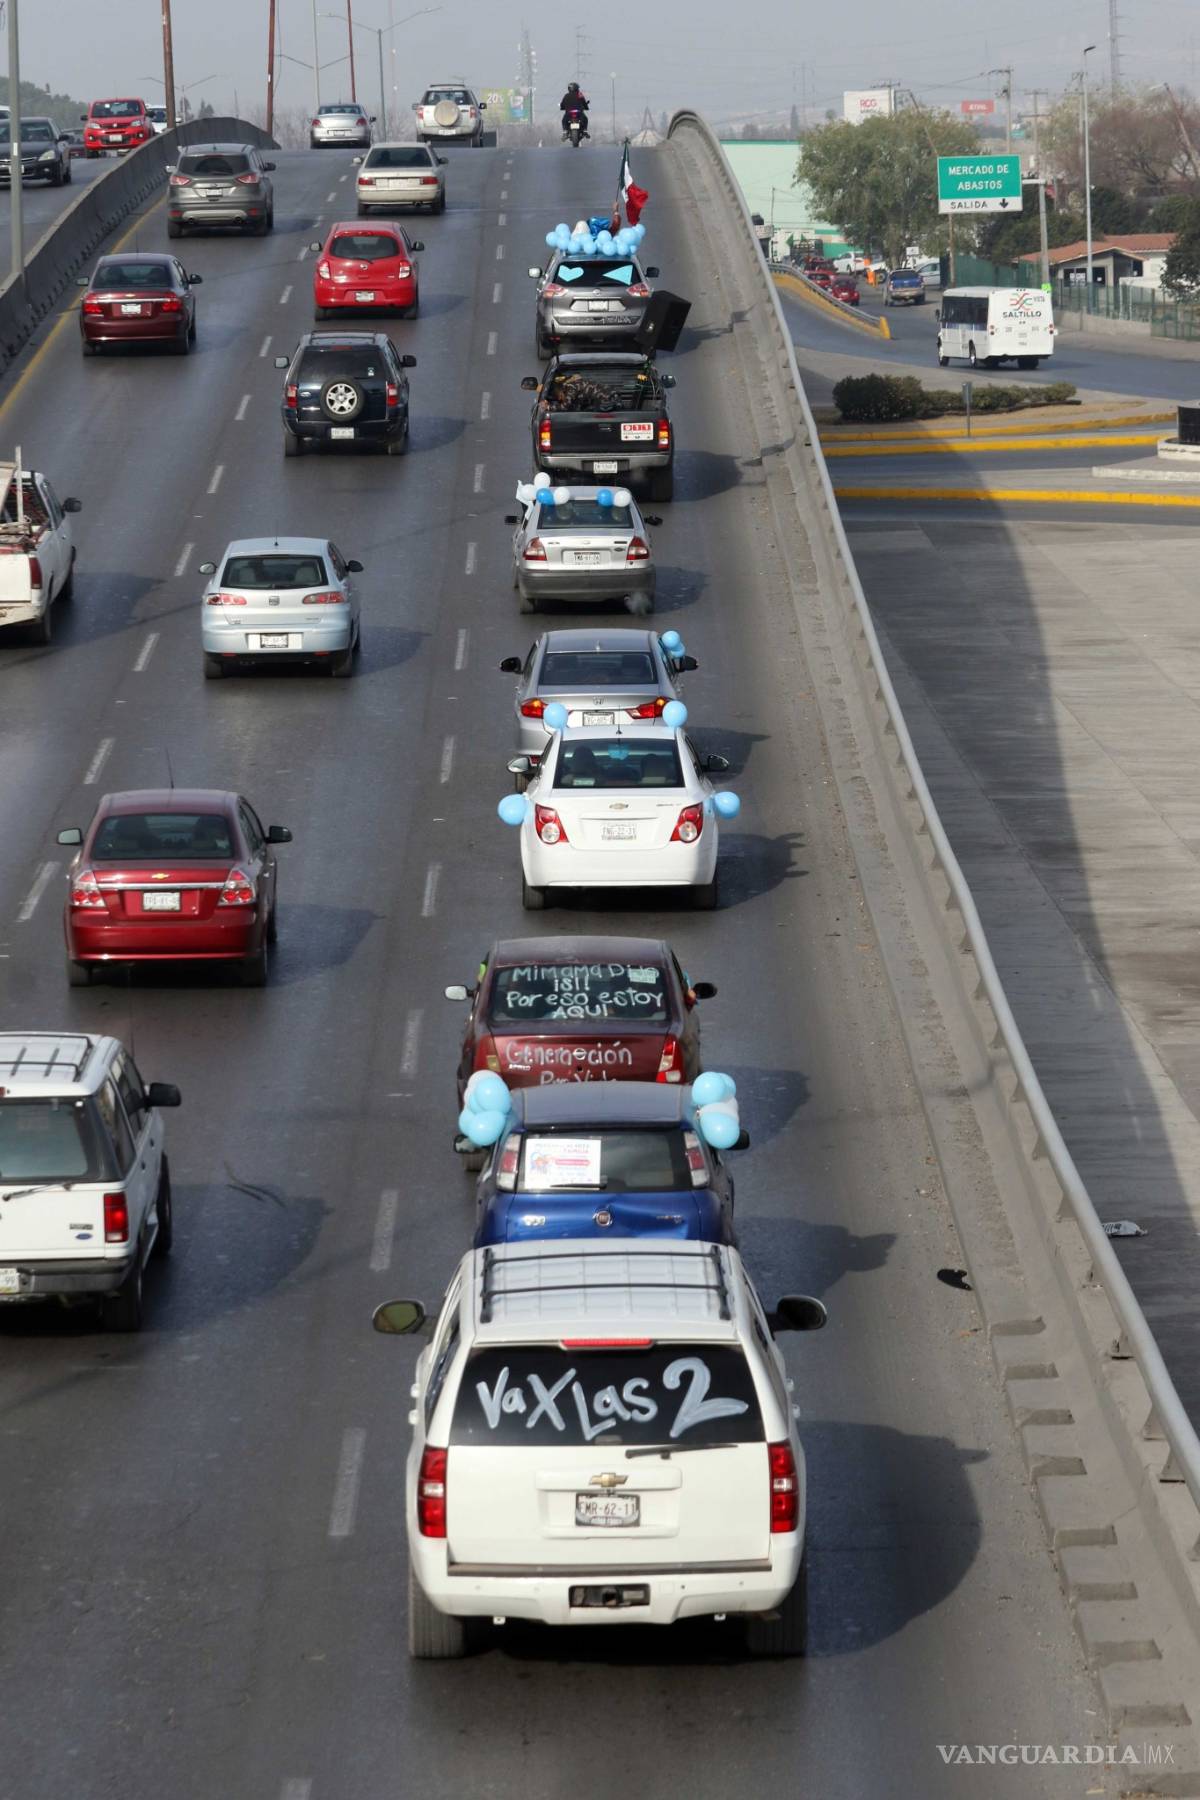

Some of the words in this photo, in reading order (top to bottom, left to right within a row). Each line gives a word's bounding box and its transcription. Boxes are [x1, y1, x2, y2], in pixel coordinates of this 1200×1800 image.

[949, 165, 994, 176] MERCADO
[997, 164, 1009, 174] DE
[957, 180, 1003, 191] ABASTOS
[950, 201, 988, 210] SALIDA
[506, 991, 543, 1008] Por
[545, 992, 589, 1007] eso
[598, 986, 664, 1007] estoy
[476, 1366, 527, 1429] Va
[526, 1367, 577, 1431] X
[572, 1376, 659, 1441] Las
[662, 1357, 749, 1438] 2
